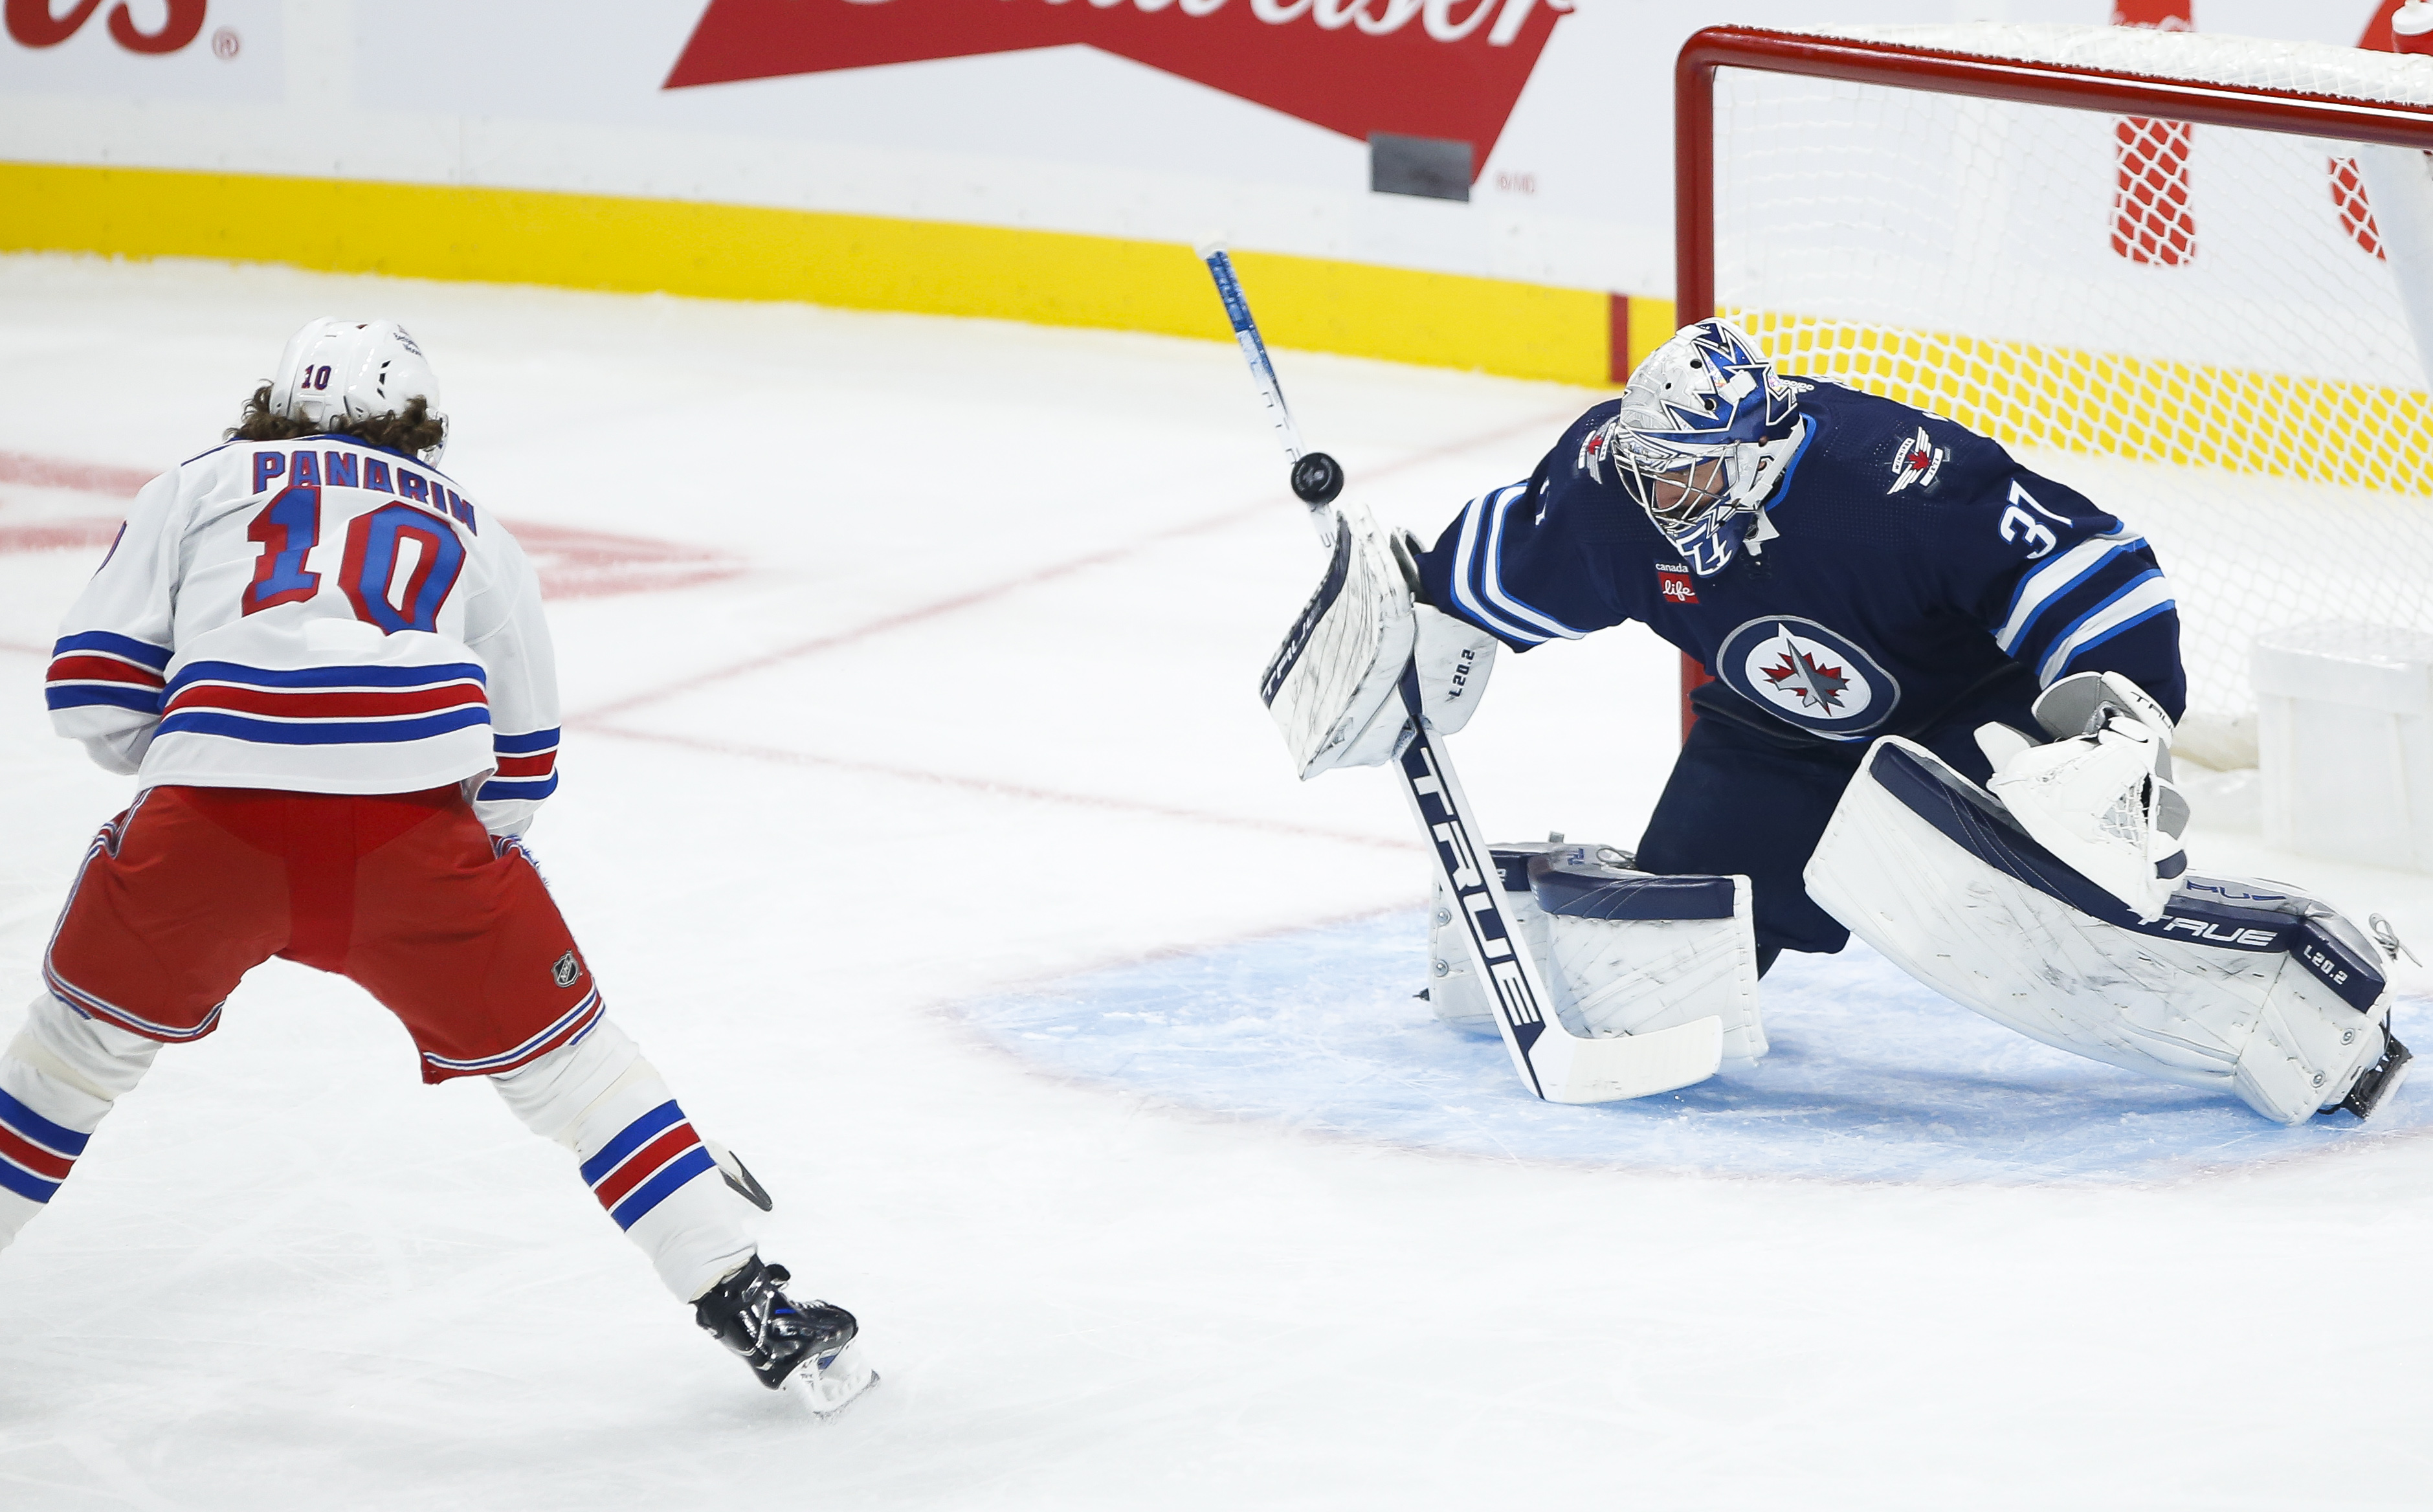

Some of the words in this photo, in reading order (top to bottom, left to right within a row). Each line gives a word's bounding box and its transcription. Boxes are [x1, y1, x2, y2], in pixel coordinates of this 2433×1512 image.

[302, 364, 331, 390] 10
[253, 450, 477, 537] PANARIN
[1998, 478, 2073, 559] 37
[241, 485, 466, 636] 10
[1655, 562, 1689, 573] canada
[1662, 579, 1695, 601] life
[1449, 649, 1475, 697] L20.2
[1413, 747, 1540, 1027] TRUE
[2127, 909, 2278, 947] TRUE
[2303, 945, 2348, 986] L20.2
